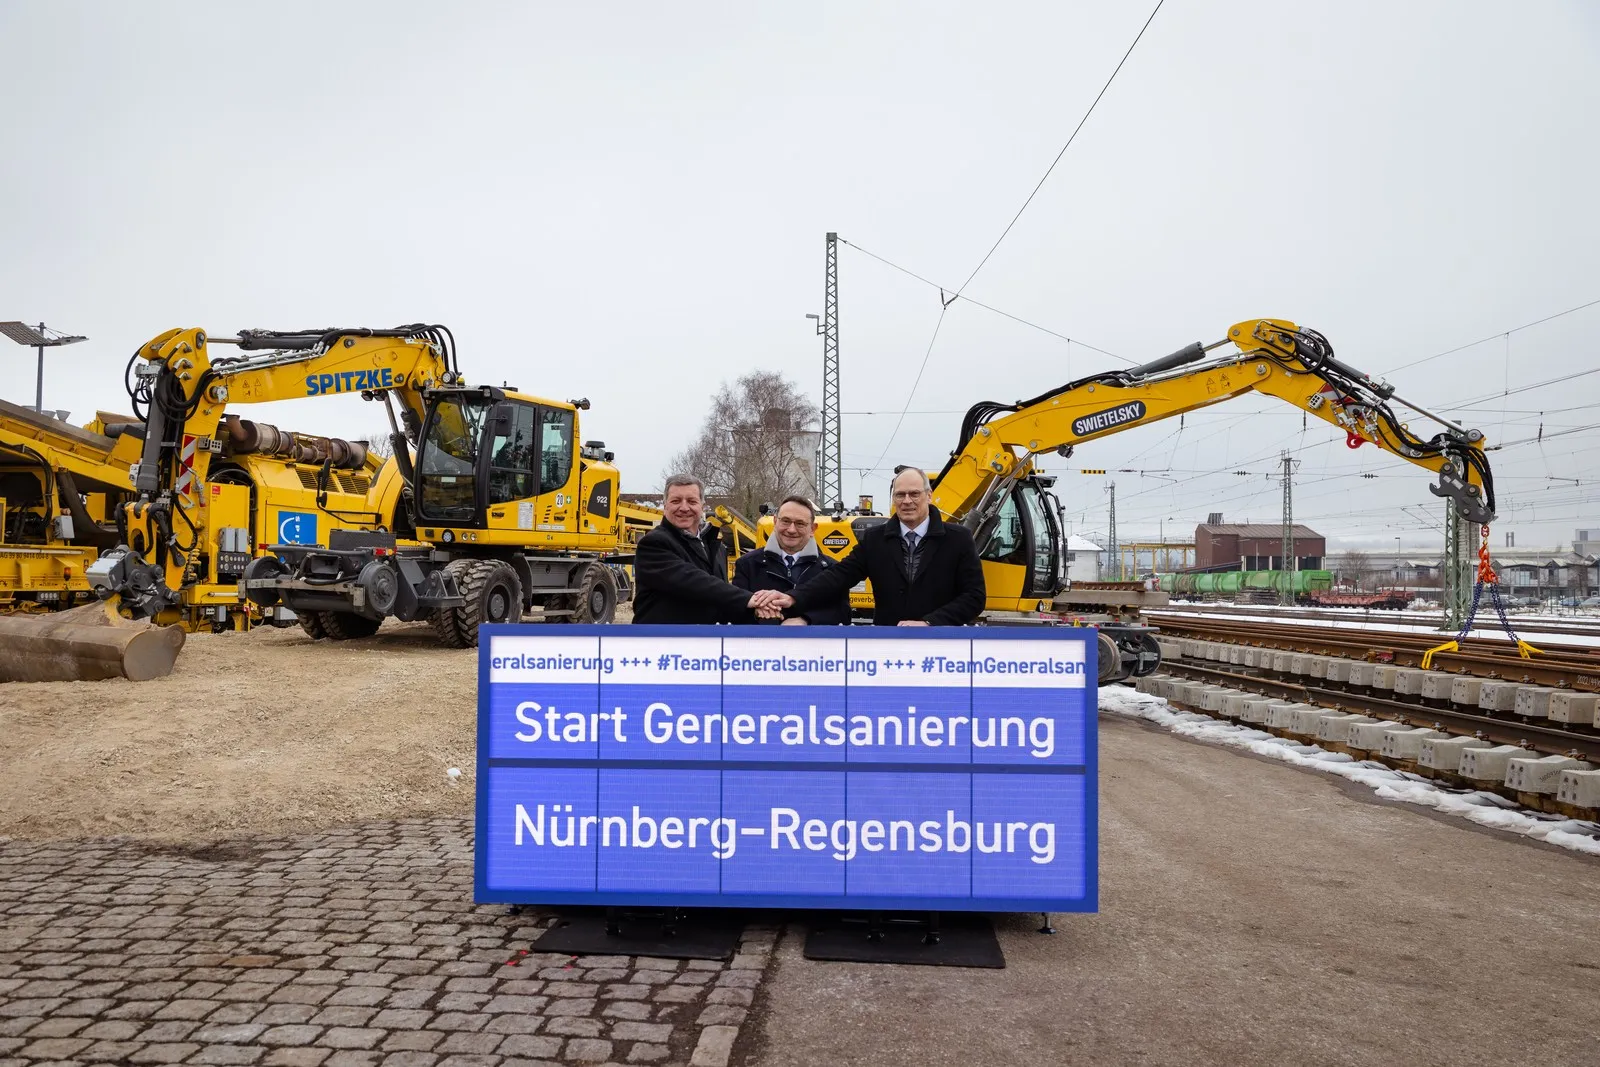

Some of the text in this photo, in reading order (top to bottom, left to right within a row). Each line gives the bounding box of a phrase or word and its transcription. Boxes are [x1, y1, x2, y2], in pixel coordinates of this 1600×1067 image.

[305, 367, 393, 396] SPITZKE
[1075, 402, 1140, 434] SWIETELSKY
[596, 495, 608, 504] 922
[658, 654, 876, 677] #TeamGeneralsanierung
[922, 657, 1086, 676] #TeamGeneralsan
[514, 701, 1055, 758] Start Generalsanierung
[515, 804, 1056, 864] Nürnberg-Regensburg
